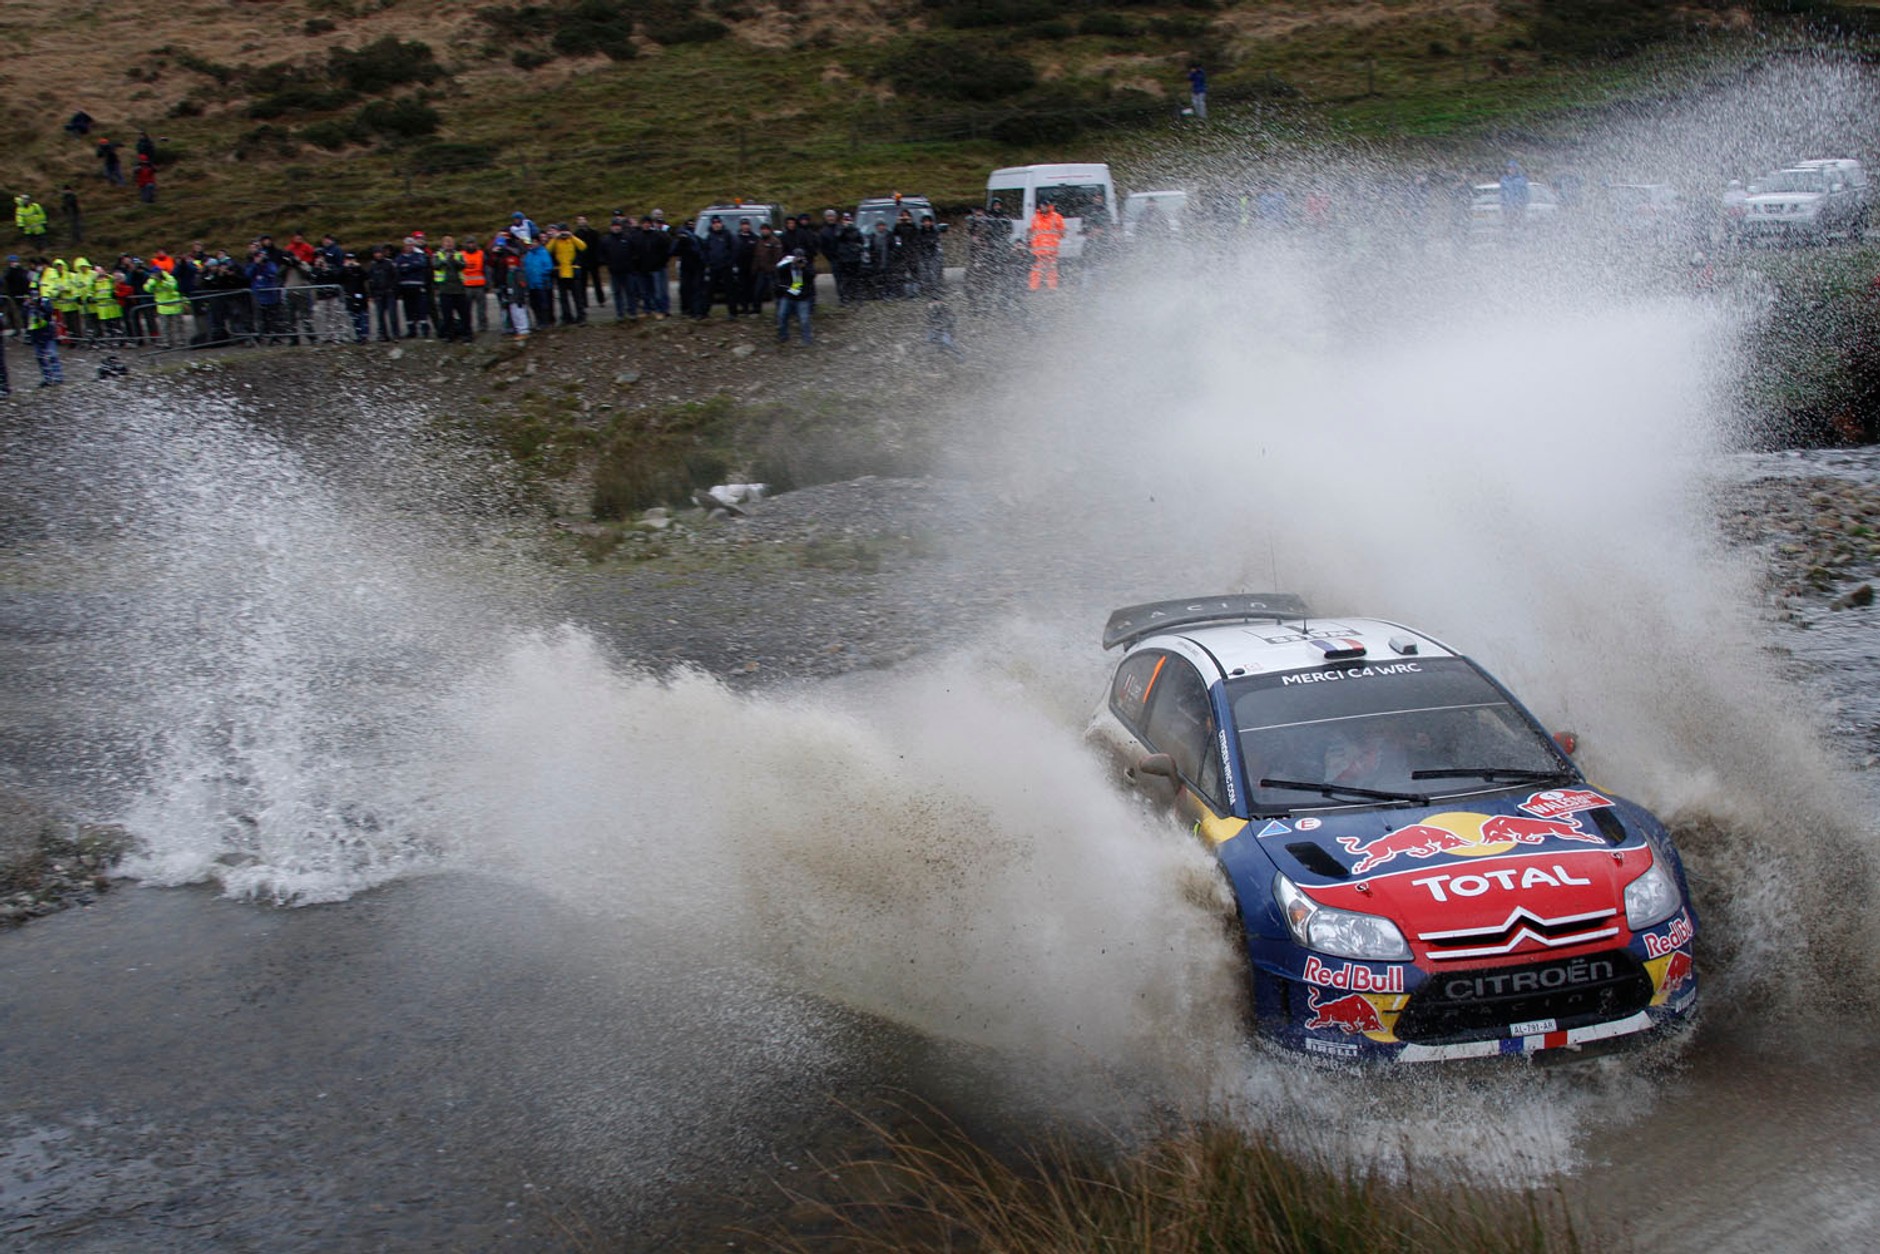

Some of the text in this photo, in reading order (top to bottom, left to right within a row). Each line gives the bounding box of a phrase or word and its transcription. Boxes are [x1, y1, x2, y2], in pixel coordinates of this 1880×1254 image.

[1281, 662, 1423, 686] MERCI C4 WRC
[1300, 818, 1315, 829] E
[1411, 865, 1591, 902] TOTAL
[1642, 920, 1680, 960] Red
[1303, 955, 1404, 993] Red Bull
[1305, 1037, 1358, 1057] PIRELLI
